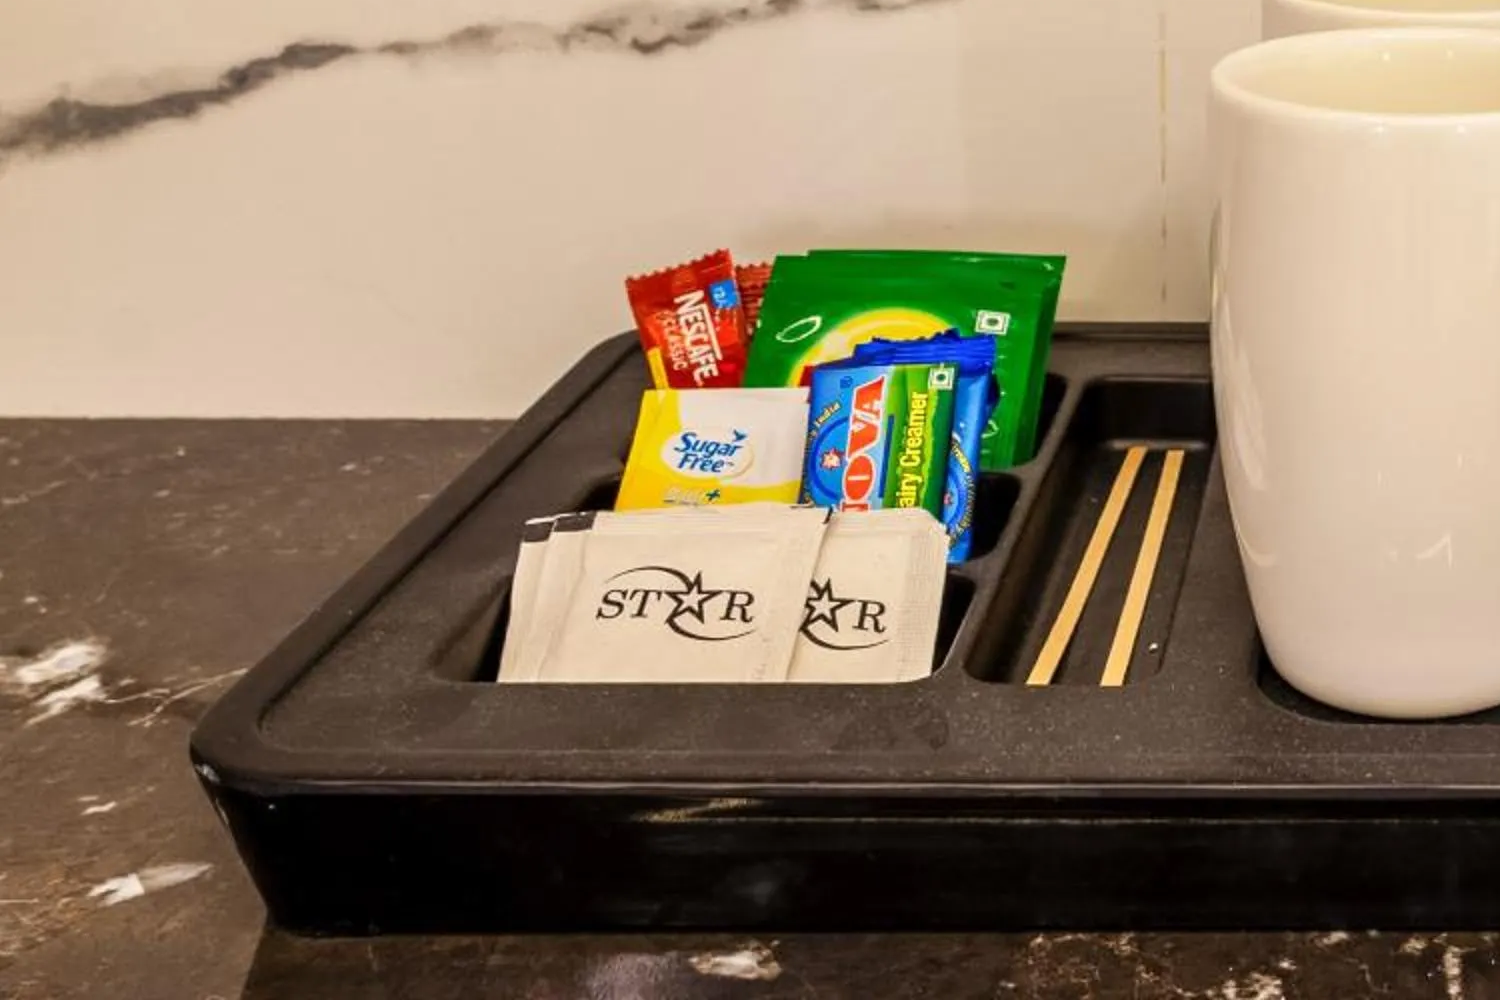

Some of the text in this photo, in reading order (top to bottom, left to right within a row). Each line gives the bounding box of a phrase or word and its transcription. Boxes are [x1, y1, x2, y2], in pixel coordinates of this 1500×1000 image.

[674, 432, 743, 458] Sugar
[678, 453, 724, 473] Free
[840, 375, 886, 511] OVA
[896, 392, 929, 508] airy Creamer
